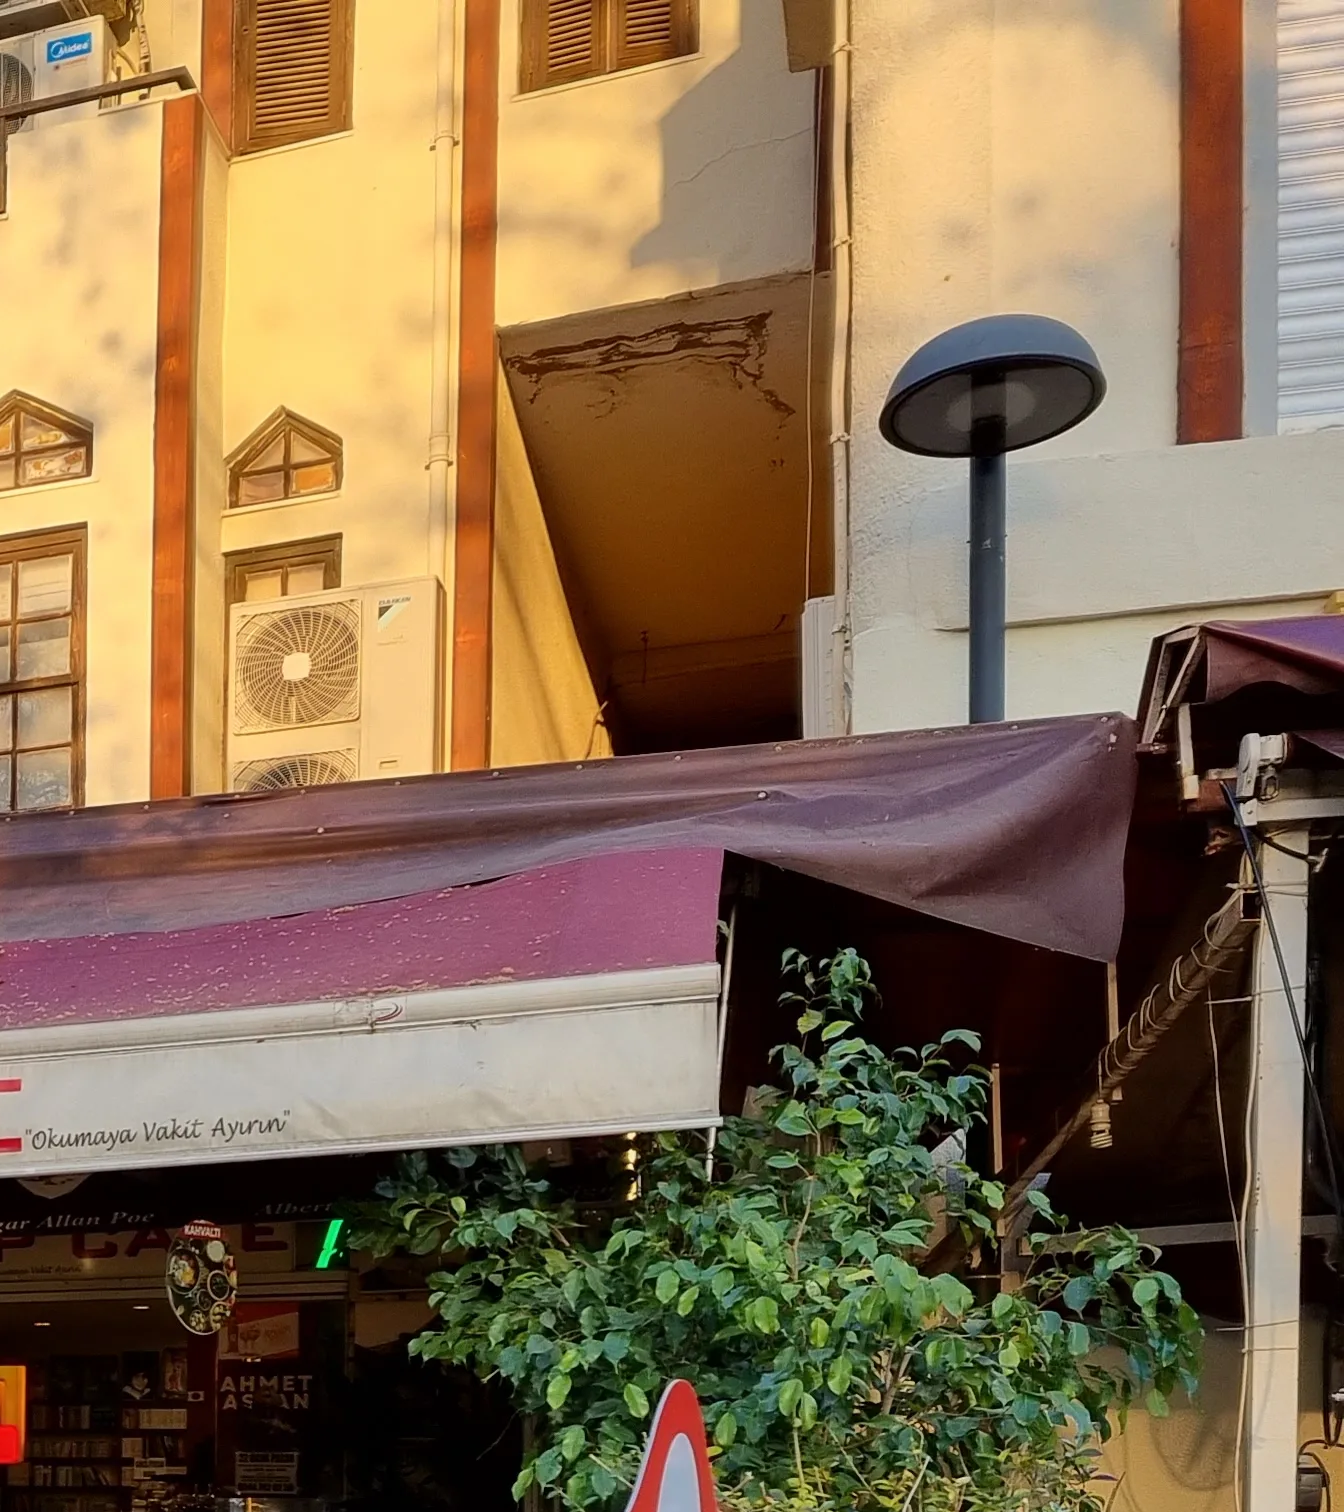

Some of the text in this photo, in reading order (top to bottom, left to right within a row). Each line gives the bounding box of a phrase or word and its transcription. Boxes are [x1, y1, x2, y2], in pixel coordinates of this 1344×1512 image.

[141, 1117, 205, 1143] Vakit
[36, 1213, 101, 1230] Allan
[110, 1210, 156, 1226] Poe
[220, 1375, 313, 1393] AHMET
[221, 1393, 310, 1411] ASAN
